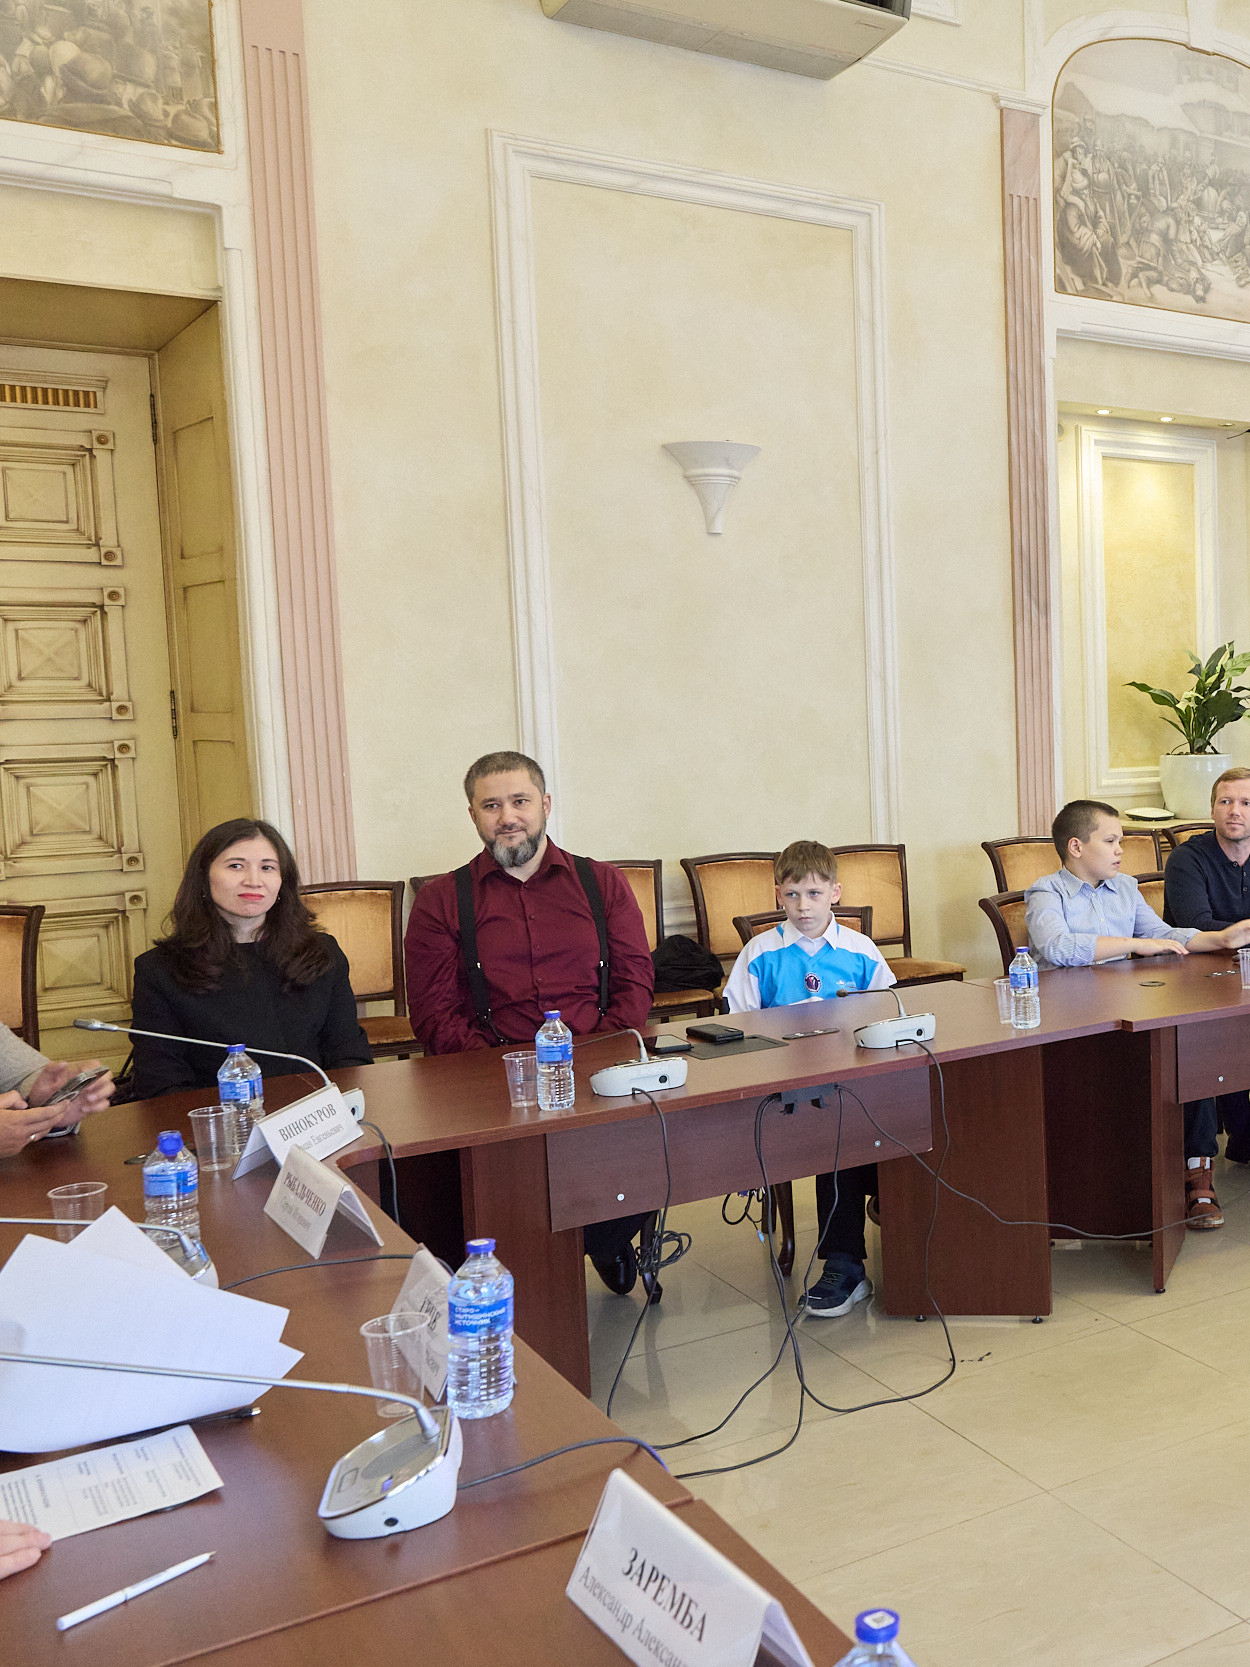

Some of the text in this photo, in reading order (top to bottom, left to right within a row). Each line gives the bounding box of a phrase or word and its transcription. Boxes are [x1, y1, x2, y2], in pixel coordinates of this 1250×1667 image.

[278, 1103, 337, 1142] ВИНОКУРОВ
[578, 1566, 634, 1634] Александр
[622, 1547, 708, 1642] ЗАРЕМБА
